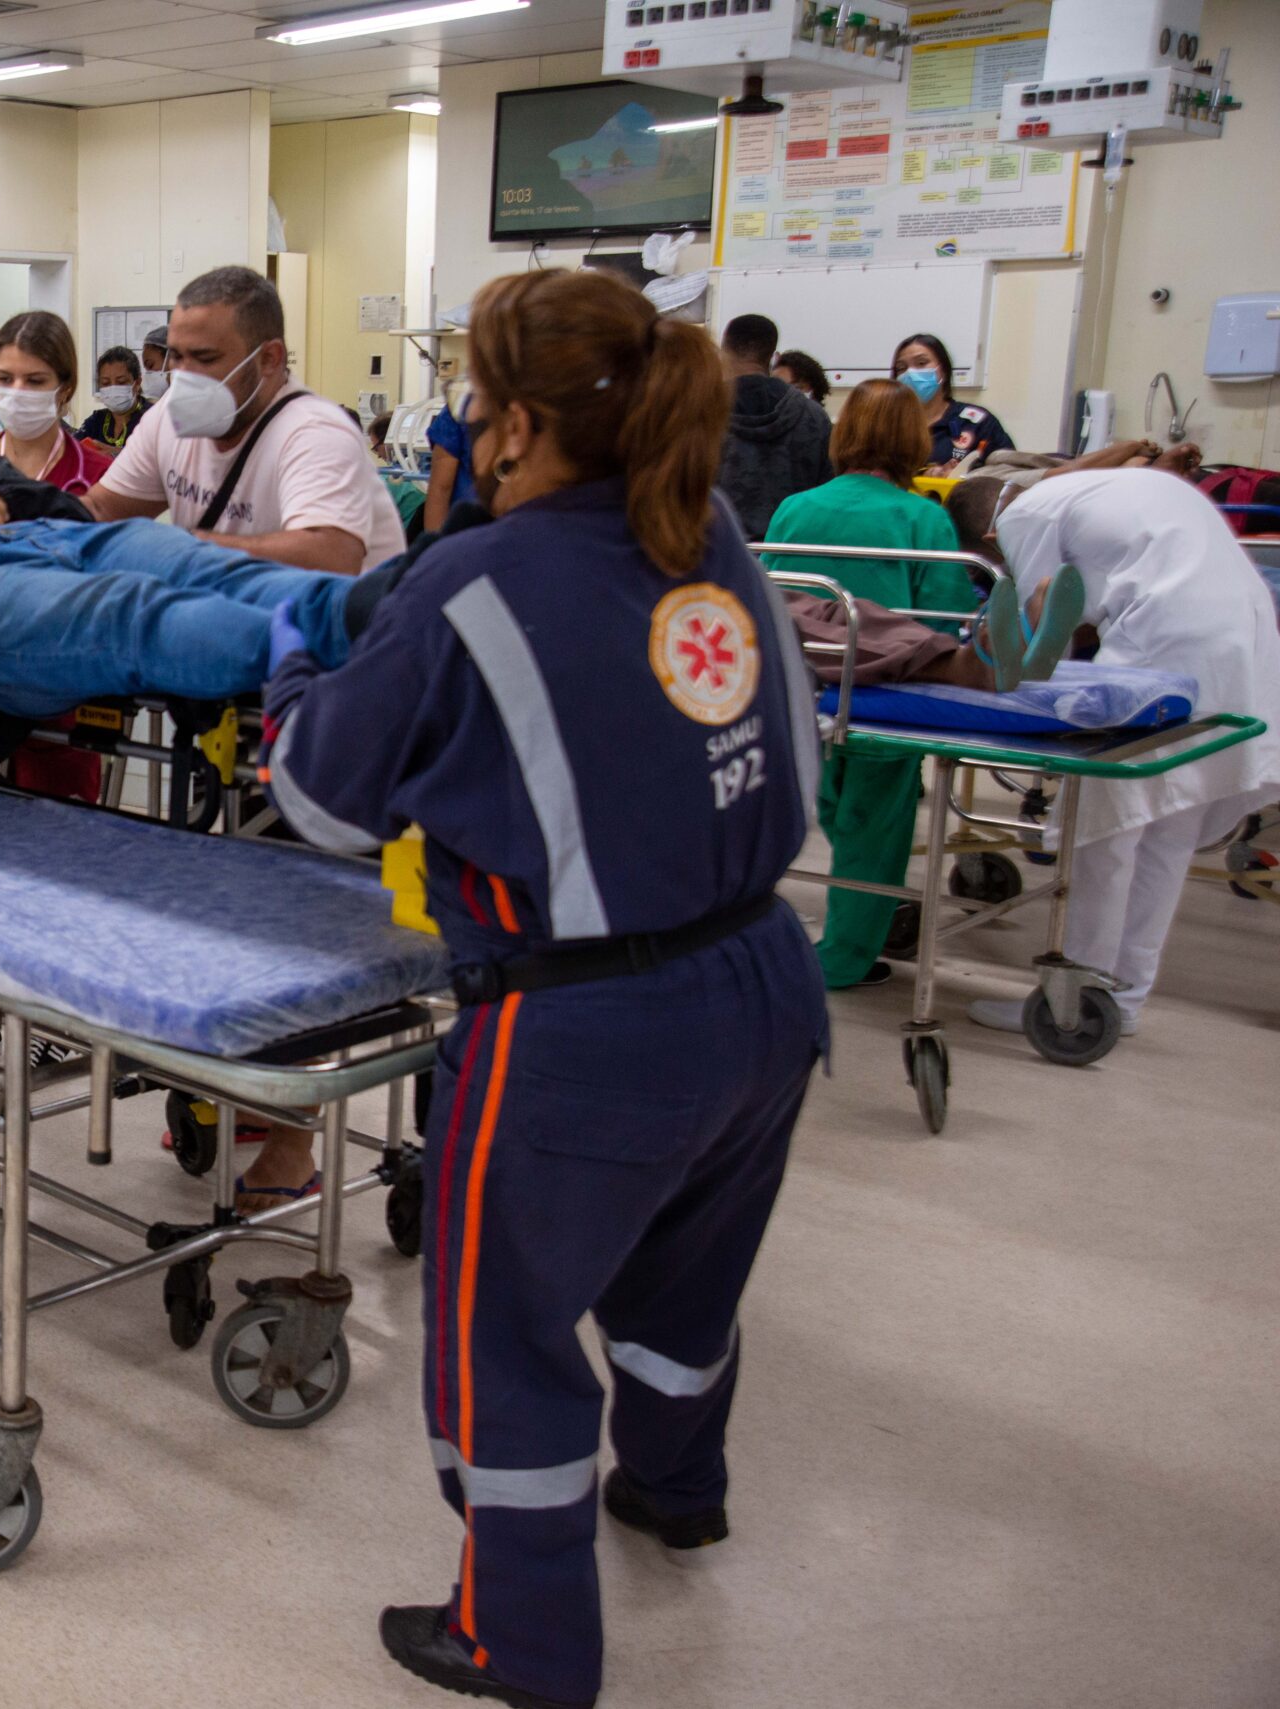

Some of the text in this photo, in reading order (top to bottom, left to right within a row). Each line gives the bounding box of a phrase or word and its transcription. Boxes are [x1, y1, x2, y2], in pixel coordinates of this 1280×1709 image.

[502, 187, 533, 204] 10:03
[707, 715, 761, 762] SAMU
[710, 748, 766, 809] 192
